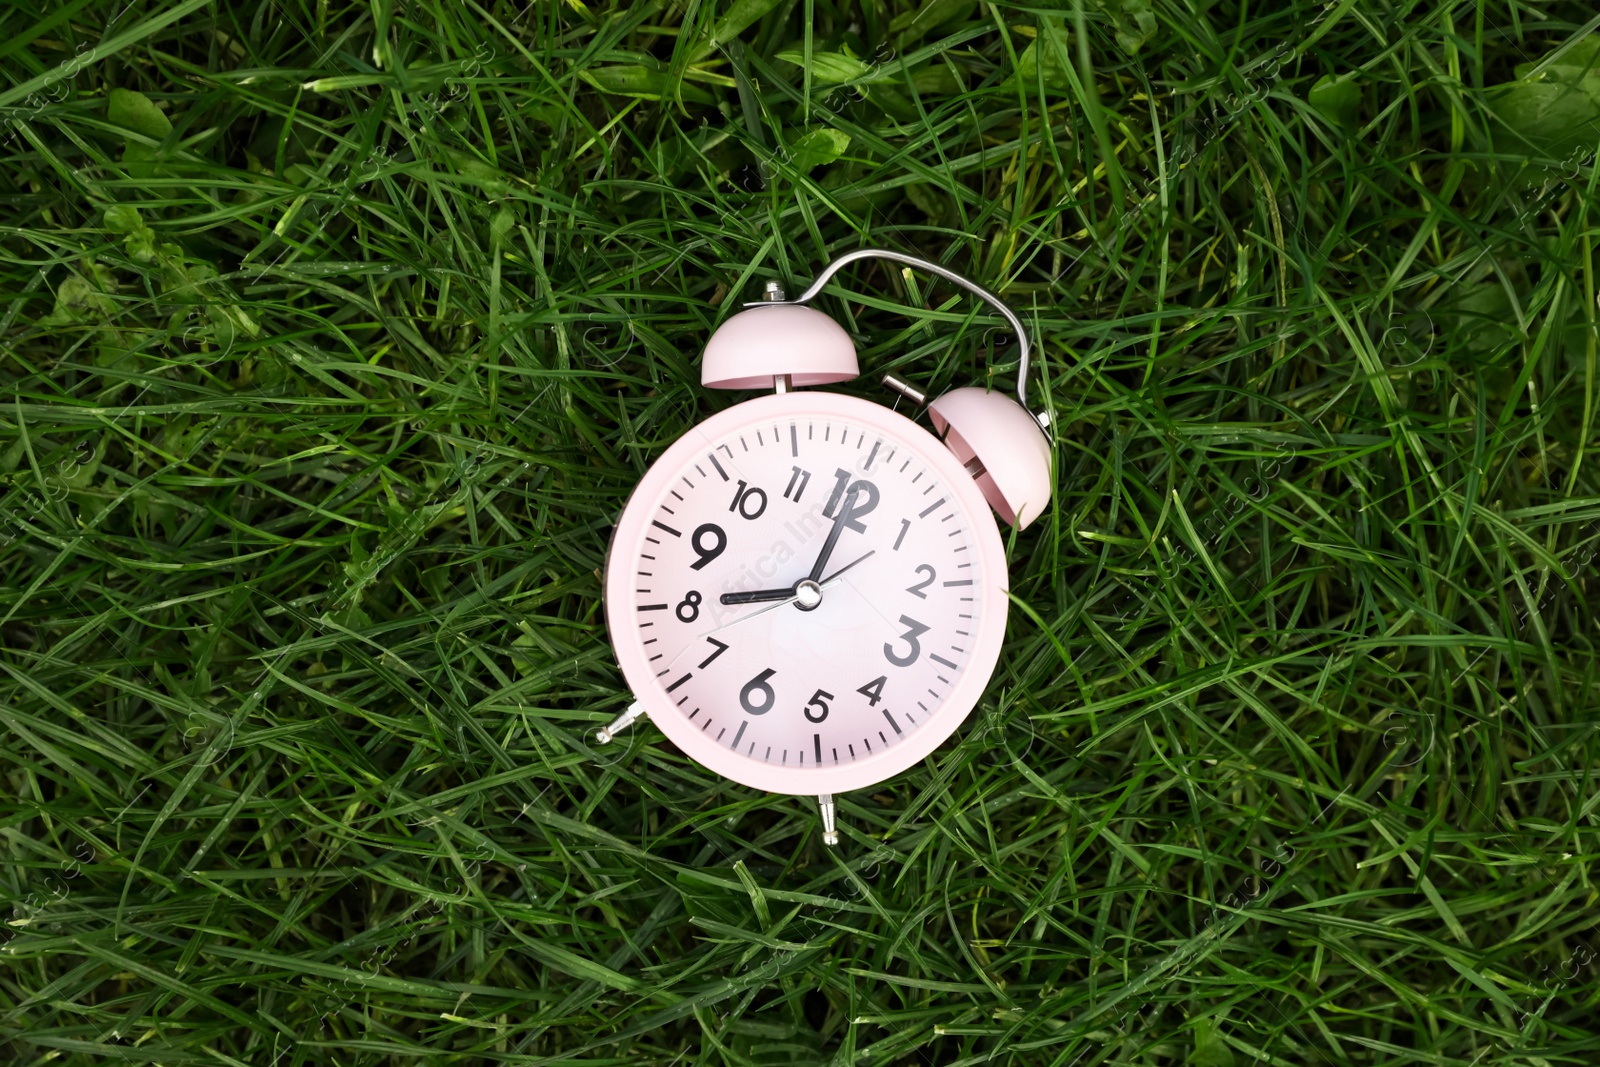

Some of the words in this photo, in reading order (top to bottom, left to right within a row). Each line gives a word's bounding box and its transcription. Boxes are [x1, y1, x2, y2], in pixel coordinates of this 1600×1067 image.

[729, 480, 768, 520] 10
[783, 466, 811, 503] 11
[822, 467, 880, 535] 12
[690, 523, 727, 571] 9
[893, 518, 911, 551] 1
[906, 564, 937, 599] 2
[676, 590, 703, 623] 8
[698, 637, 730, 669] 7
[884, 614, 931, 667] 3
[740, 668, 776, 715] 6
[804, 689, 834, 723] 5
[856, 676, 887, 707] 4
